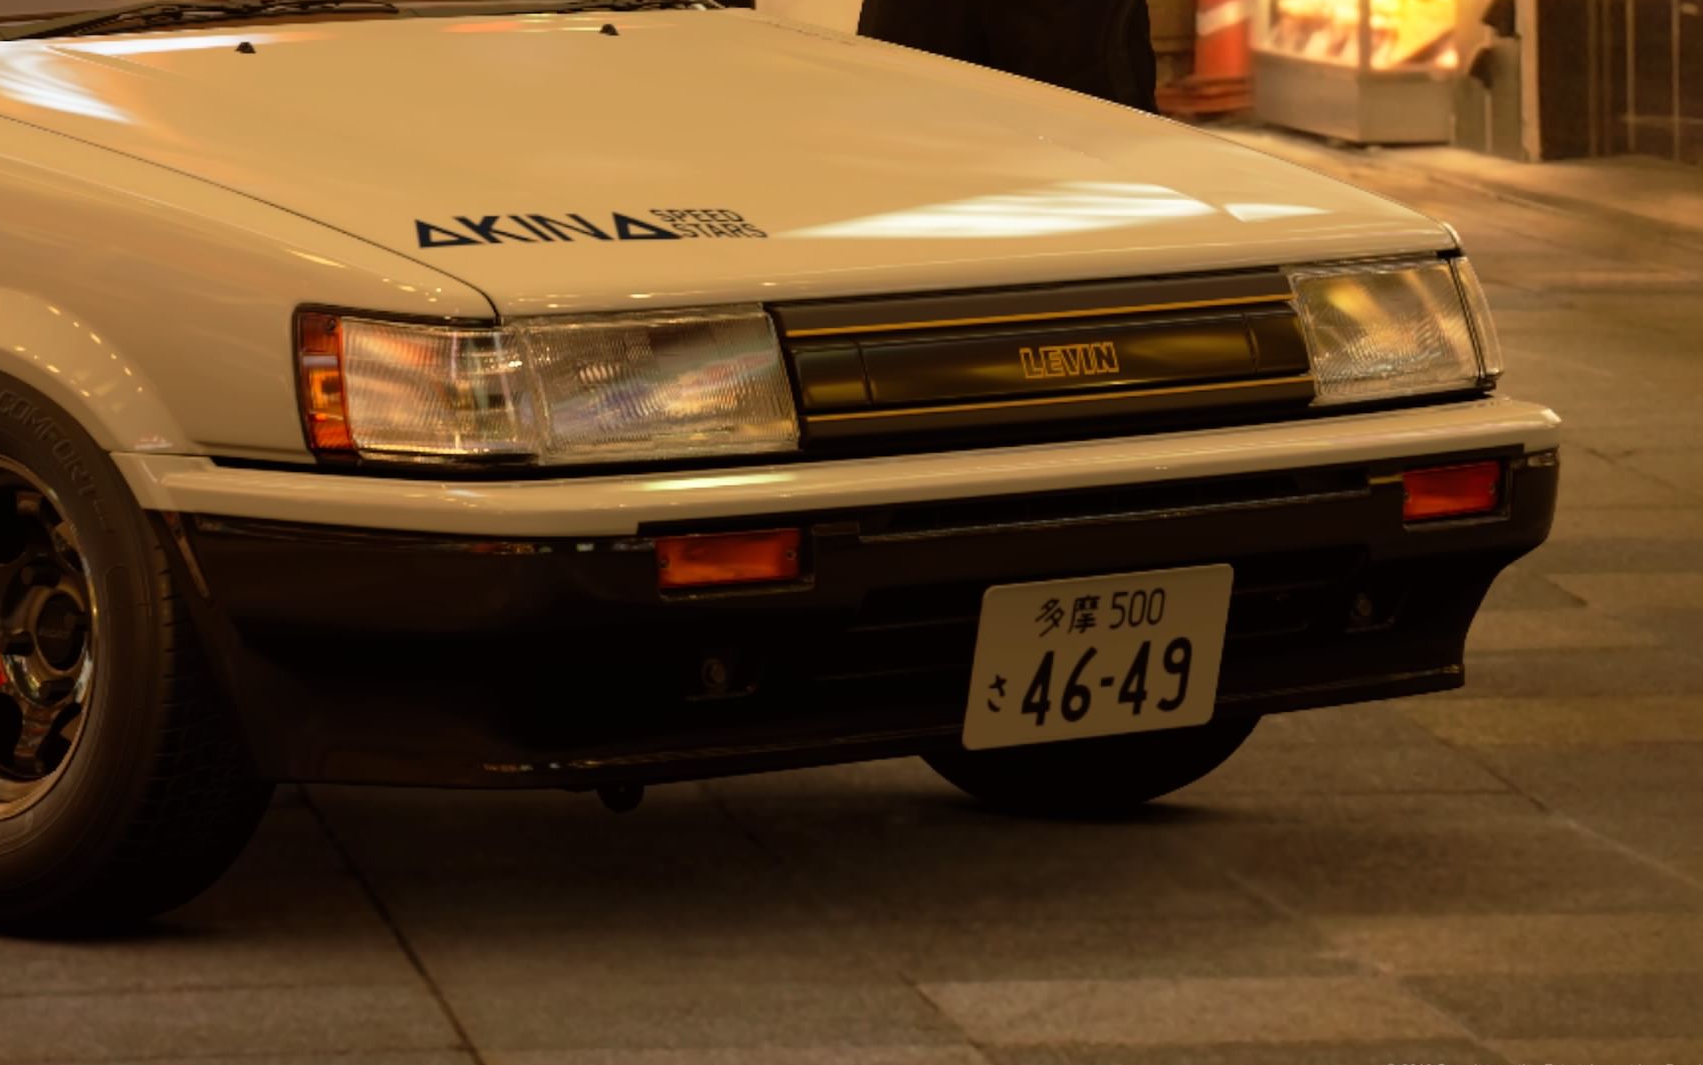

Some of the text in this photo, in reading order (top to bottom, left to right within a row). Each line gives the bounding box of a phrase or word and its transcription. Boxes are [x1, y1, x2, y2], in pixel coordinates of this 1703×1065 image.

[414, 210, 683, 248] AKINA
[649, 208, 744, 223] SPEED
[670, 221, 768, 238] STARS
[1019, 342, 1120, 379] LEVIN
[1035, 588, 1166, 637] 多摩 500
[987, 636, 1193, 727] さ 46-49
